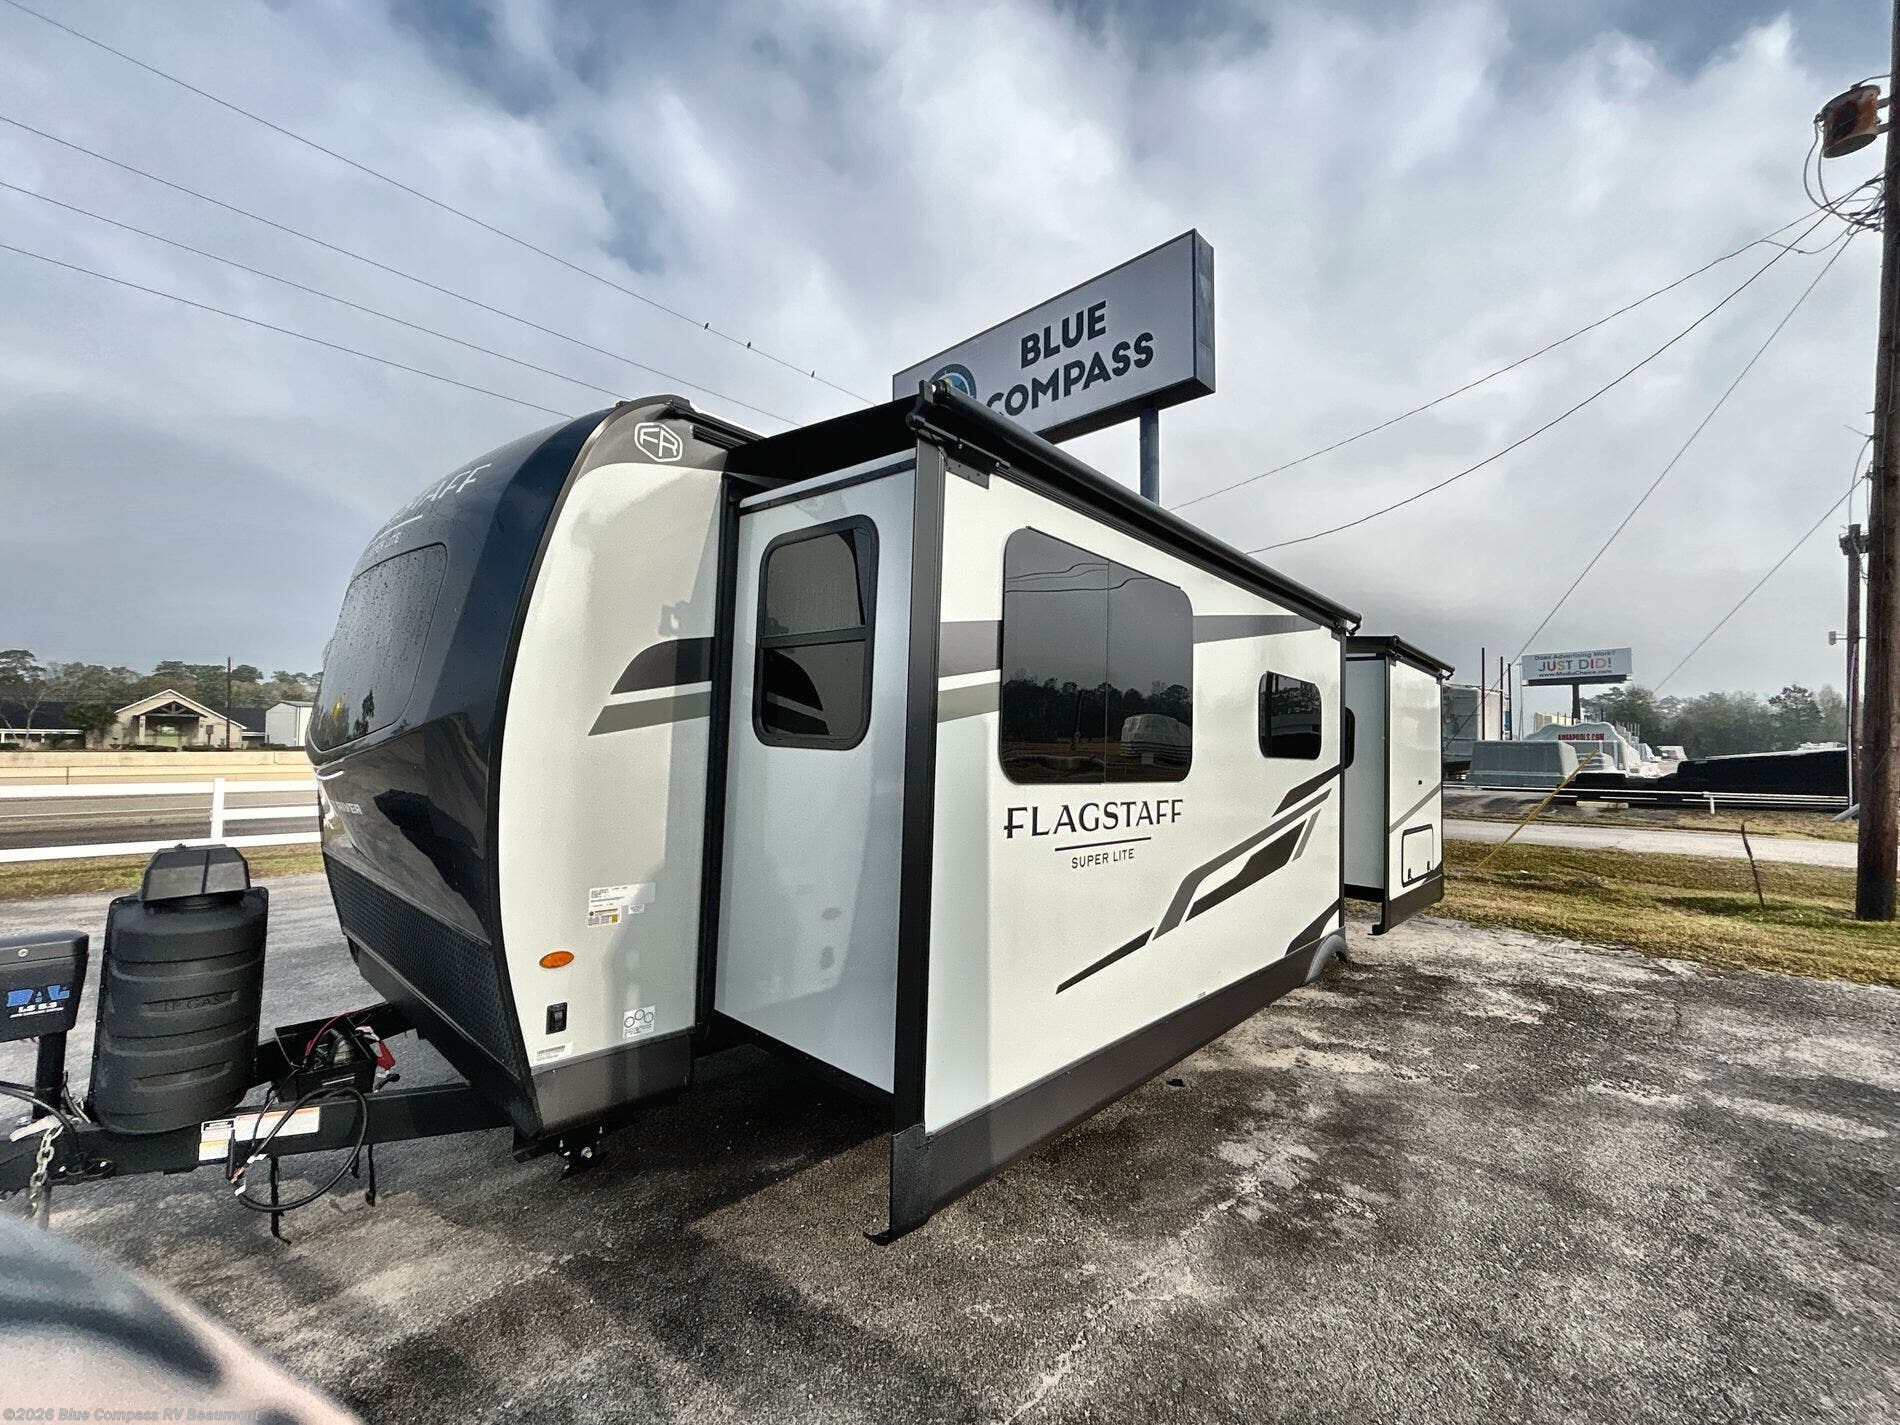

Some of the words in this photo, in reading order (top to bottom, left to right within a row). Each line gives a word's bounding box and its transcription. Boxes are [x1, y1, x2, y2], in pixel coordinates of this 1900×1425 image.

[1021, 300, 1107, 369] BLUE
[986, 331, 1154, 417] COMPASS
[1538, 659, 1573, 672] JUST
[1579, 657, 1612, 670] DID!
[1553, 652, 1592, 660] Advertising
[1593, 650, 1616, 658] Work?
[1538, 669, 1613, 678] www.MediaChoice.com
[1003, 799, 1183, 839] FLAGSTAFF
[1071, 852, 1109, 869] SUPER
[1113, 848, 1135, 865] LITE
